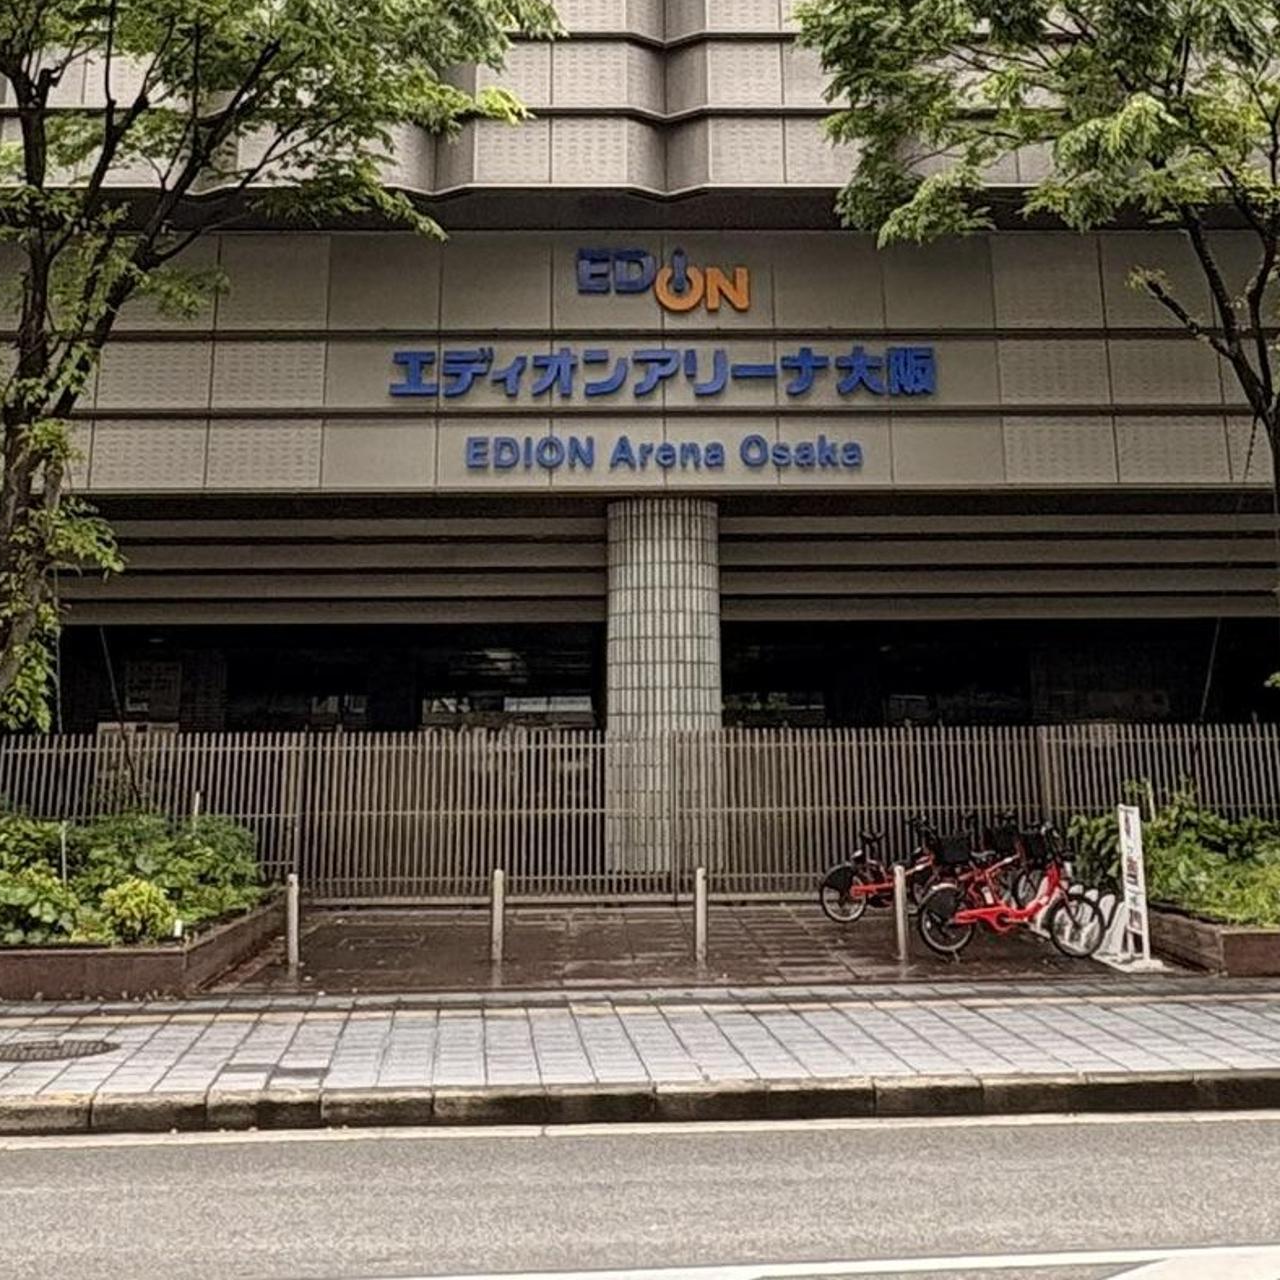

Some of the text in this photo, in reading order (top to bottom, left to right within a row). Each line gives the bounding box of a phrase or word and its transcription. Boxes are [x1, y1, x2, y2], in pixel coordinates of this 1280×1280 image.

[576, 247, 751, 311] EDION
[389, 345, 937, 397] エディオンアリーナ大阪
[465, 434, 863, 469] EDION Arena Osaka
